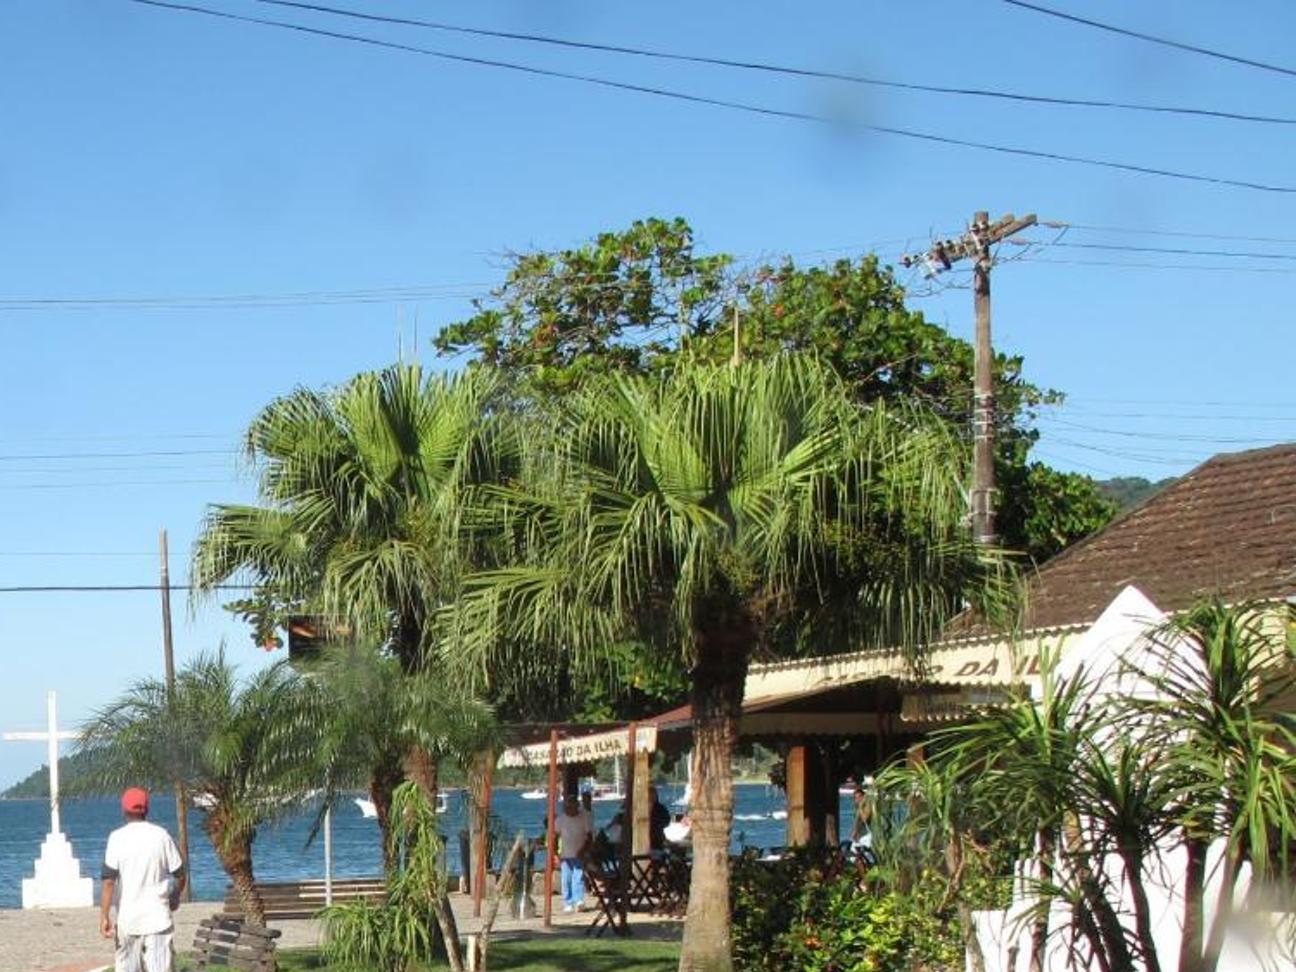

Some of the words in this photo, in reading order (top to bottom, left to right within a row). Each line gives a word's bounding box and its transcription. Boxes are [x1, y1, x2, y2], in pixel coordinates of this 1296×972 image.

[954, 659, 999, 676] DA
[577, 746, 592, 757] DA
[594, 739, 621, 753] ILHA
